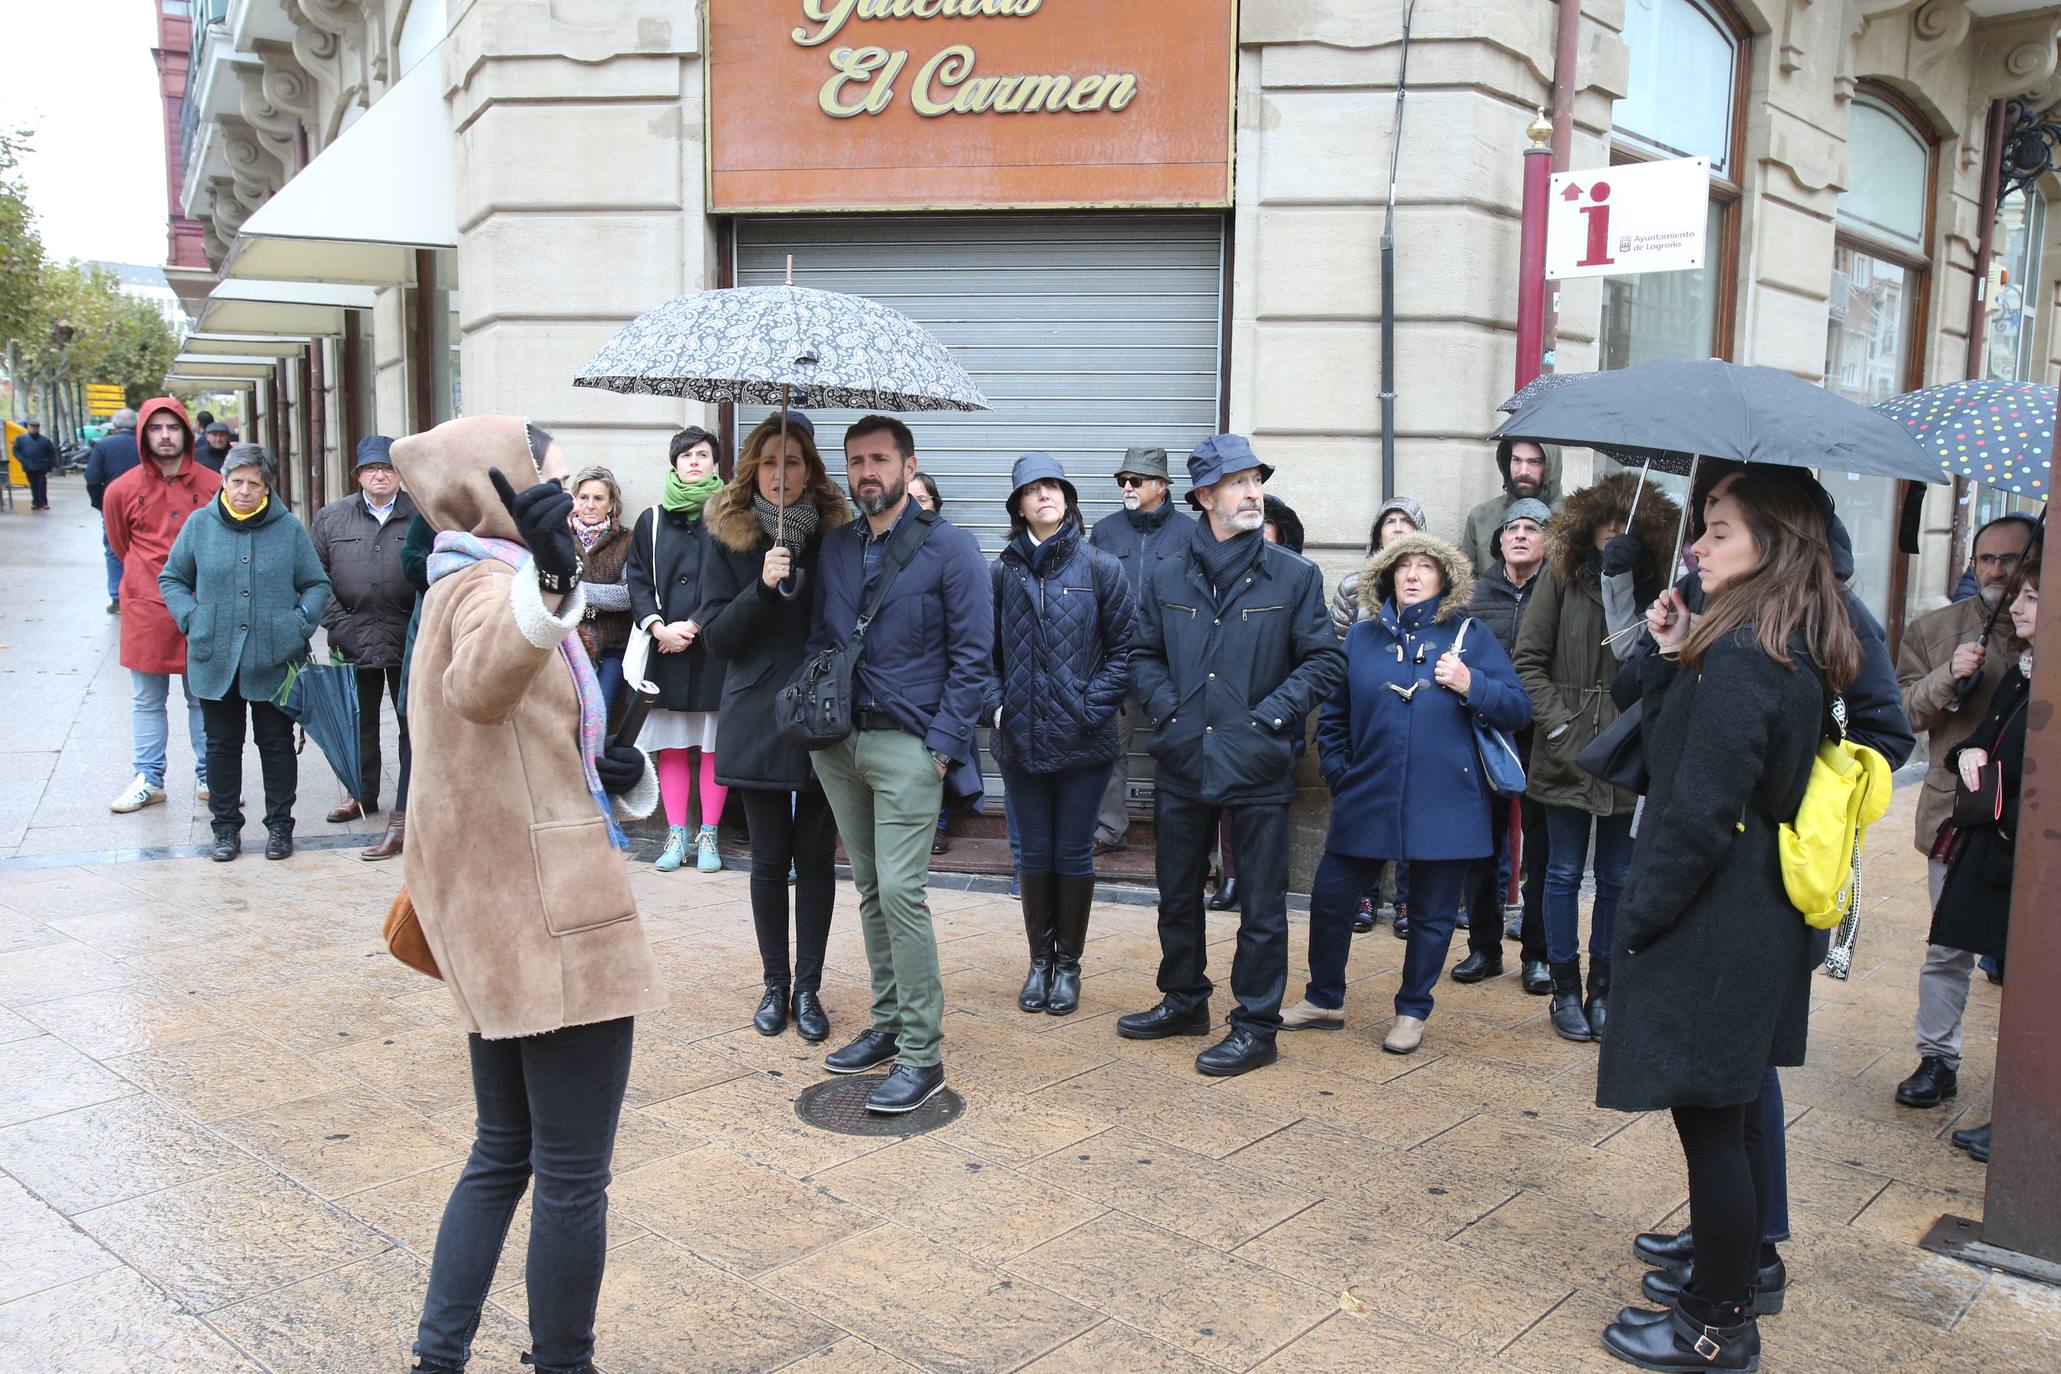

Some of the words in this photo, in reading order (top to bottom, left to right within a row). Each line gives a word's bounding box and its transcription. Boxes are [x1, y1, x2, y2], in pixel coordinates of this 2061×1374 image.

[818, 45, 908, 118] El
[910, 44, 1137, 118] Carmen
[1634, 231, 1695, 243] Ayuntamiento
[1633, 244, 1644, 252] de
